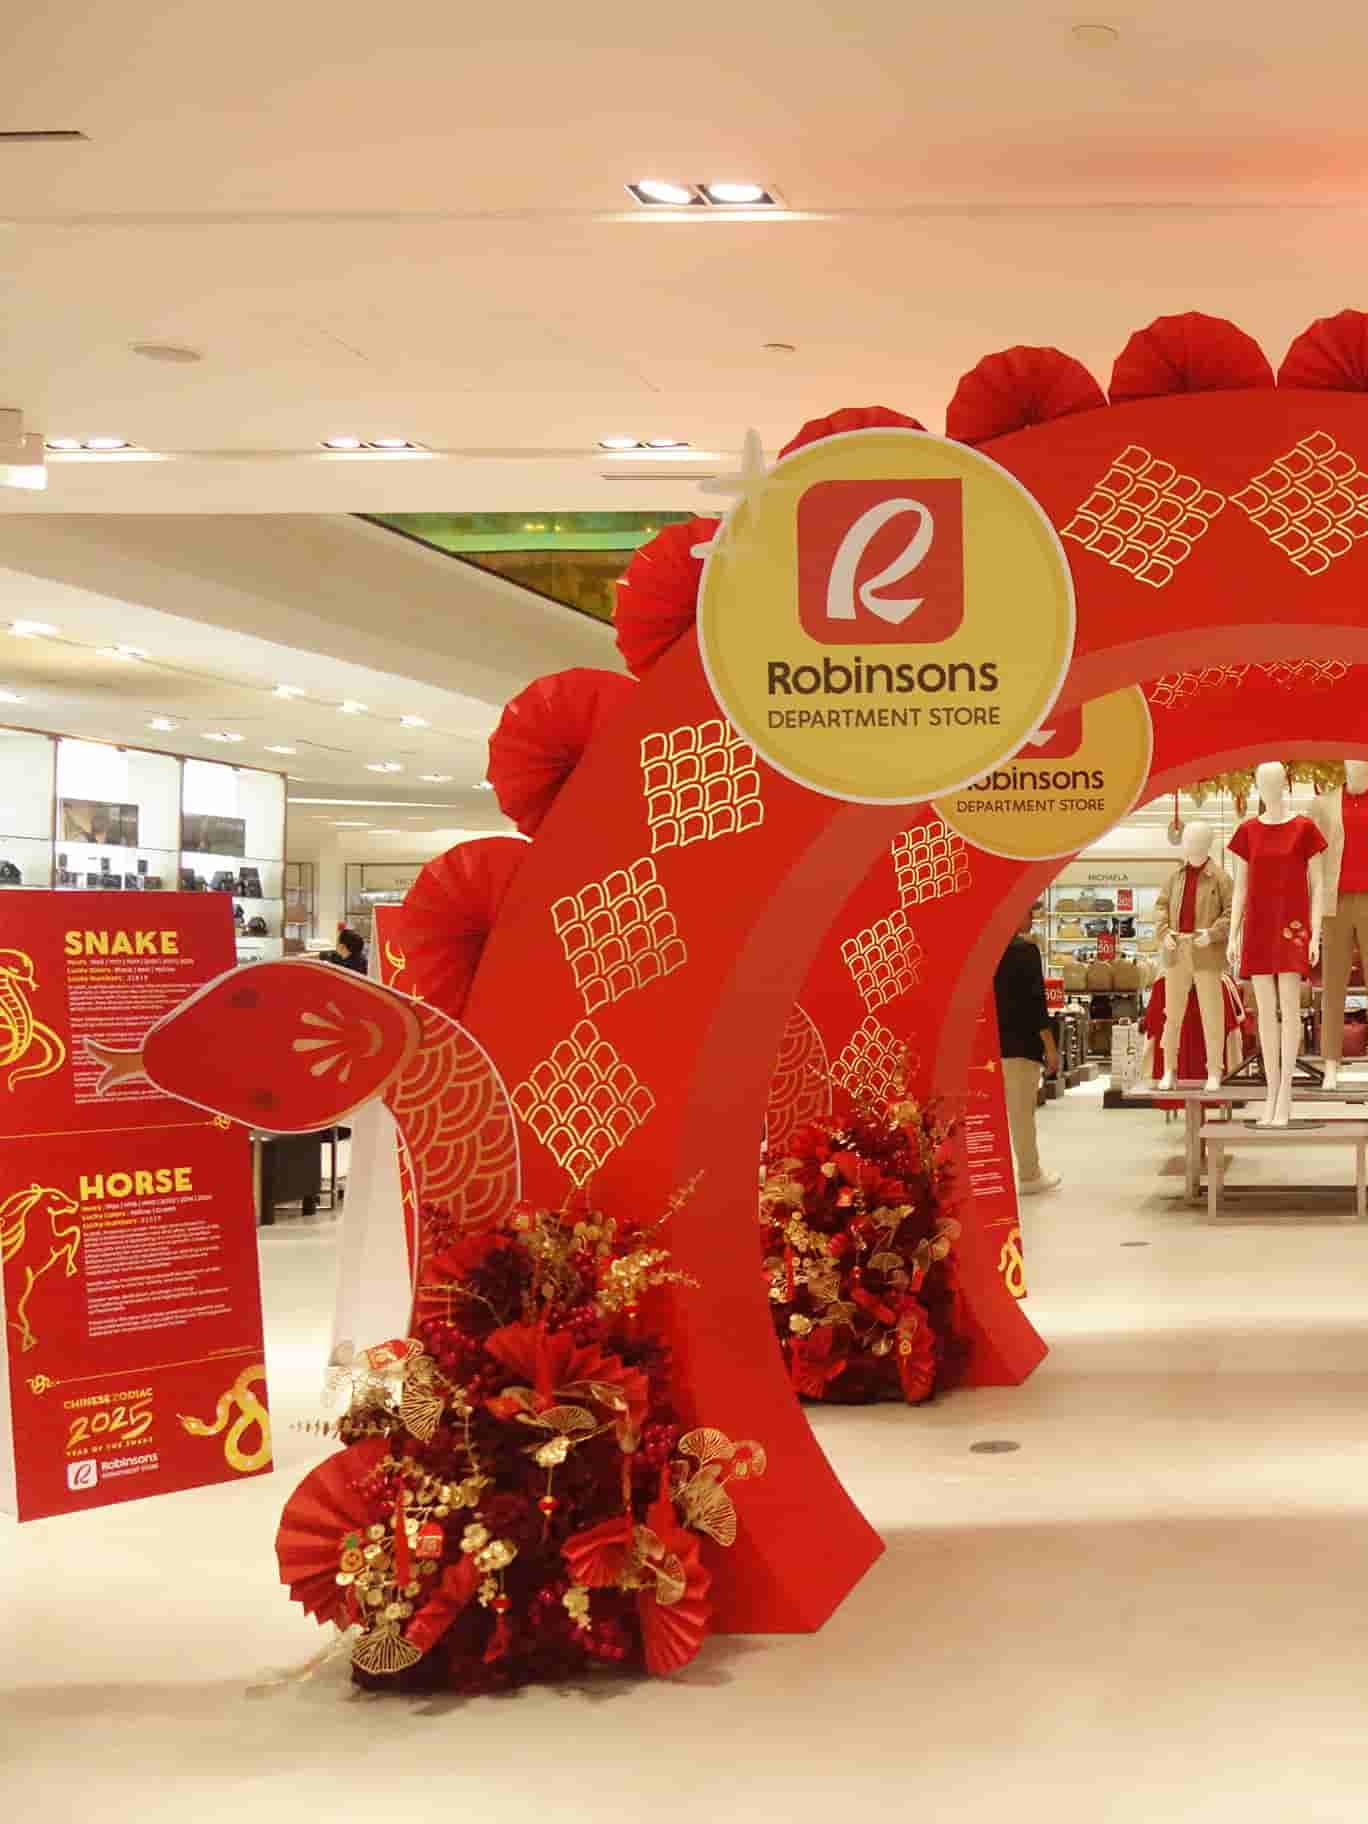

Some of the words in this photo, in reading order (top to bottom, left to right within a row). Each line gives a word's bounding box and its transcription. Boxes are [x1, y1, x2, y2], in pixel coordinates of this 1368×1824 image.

[767, 656, 1000, 696] Robinsons
[768, 708, 920, 729] DEPARTMENT
[929, 706, 1000, 726] STORE
[967, 767, 1104, 791] obinsons
[957, 800, 1055, 813] DEPARTMENT
[1060, 798, 1104, 811] STORE
[64, 930, 178, 956] SNAKE
[80, 1167, 192, 1201] HORSE
[64, 1393, 112, 1409] CHINESE
[112, 1387, 153, 1402] ZODIAC
[65, 1398, 153, 1449] 2025
[101, 1452, 160, 1471] Robinsons
